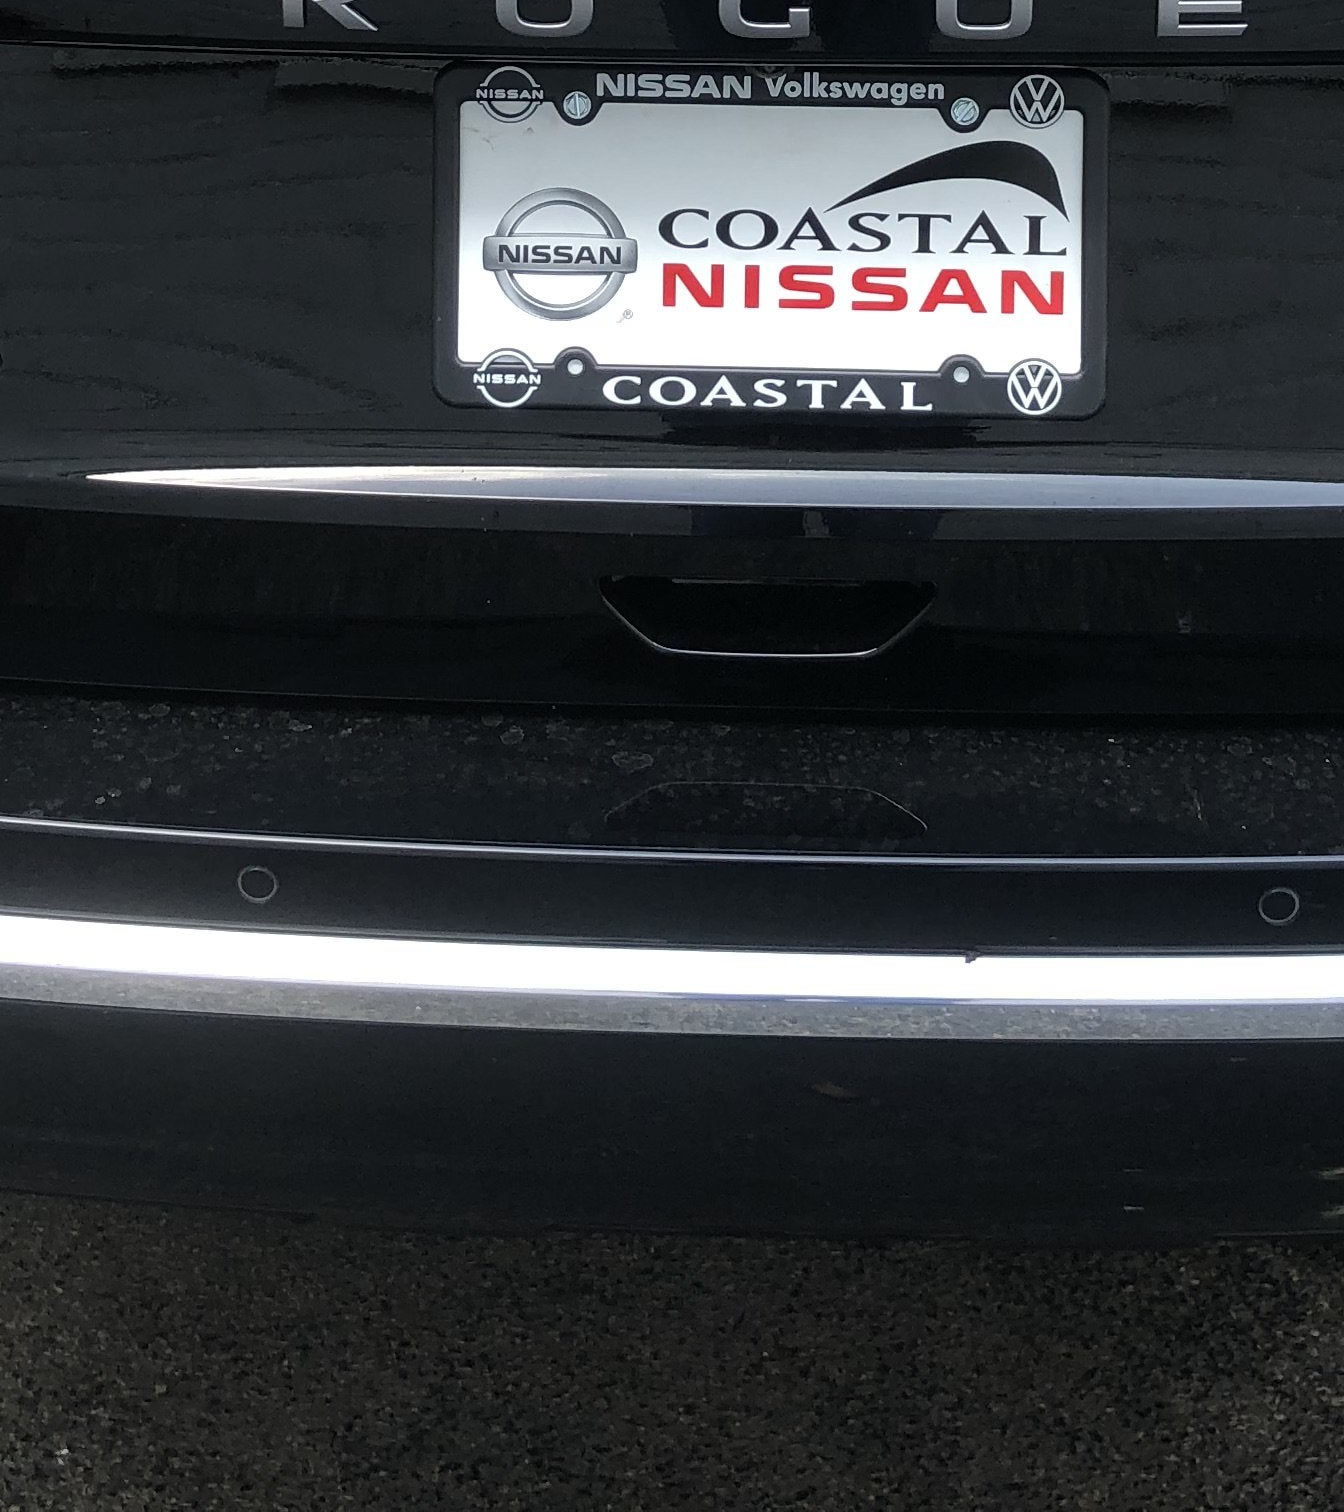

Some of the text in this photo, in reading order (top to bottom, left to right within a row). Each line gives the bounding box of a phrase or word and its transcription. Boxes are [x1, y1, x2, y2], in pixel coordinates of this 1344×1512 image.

[475, 88, 544, 100] NISSAN
[596, 71, 945, 106] NISSAN Volkswagen
[658, 207, 1068, 255] COASTAL
[498, 244, 622, 266] NISSAN
[662, 263, 1065, 315] NISSAN
[472, 372, 542, 386] NISSAN
[602, 375, 933, 412] COASTAL
